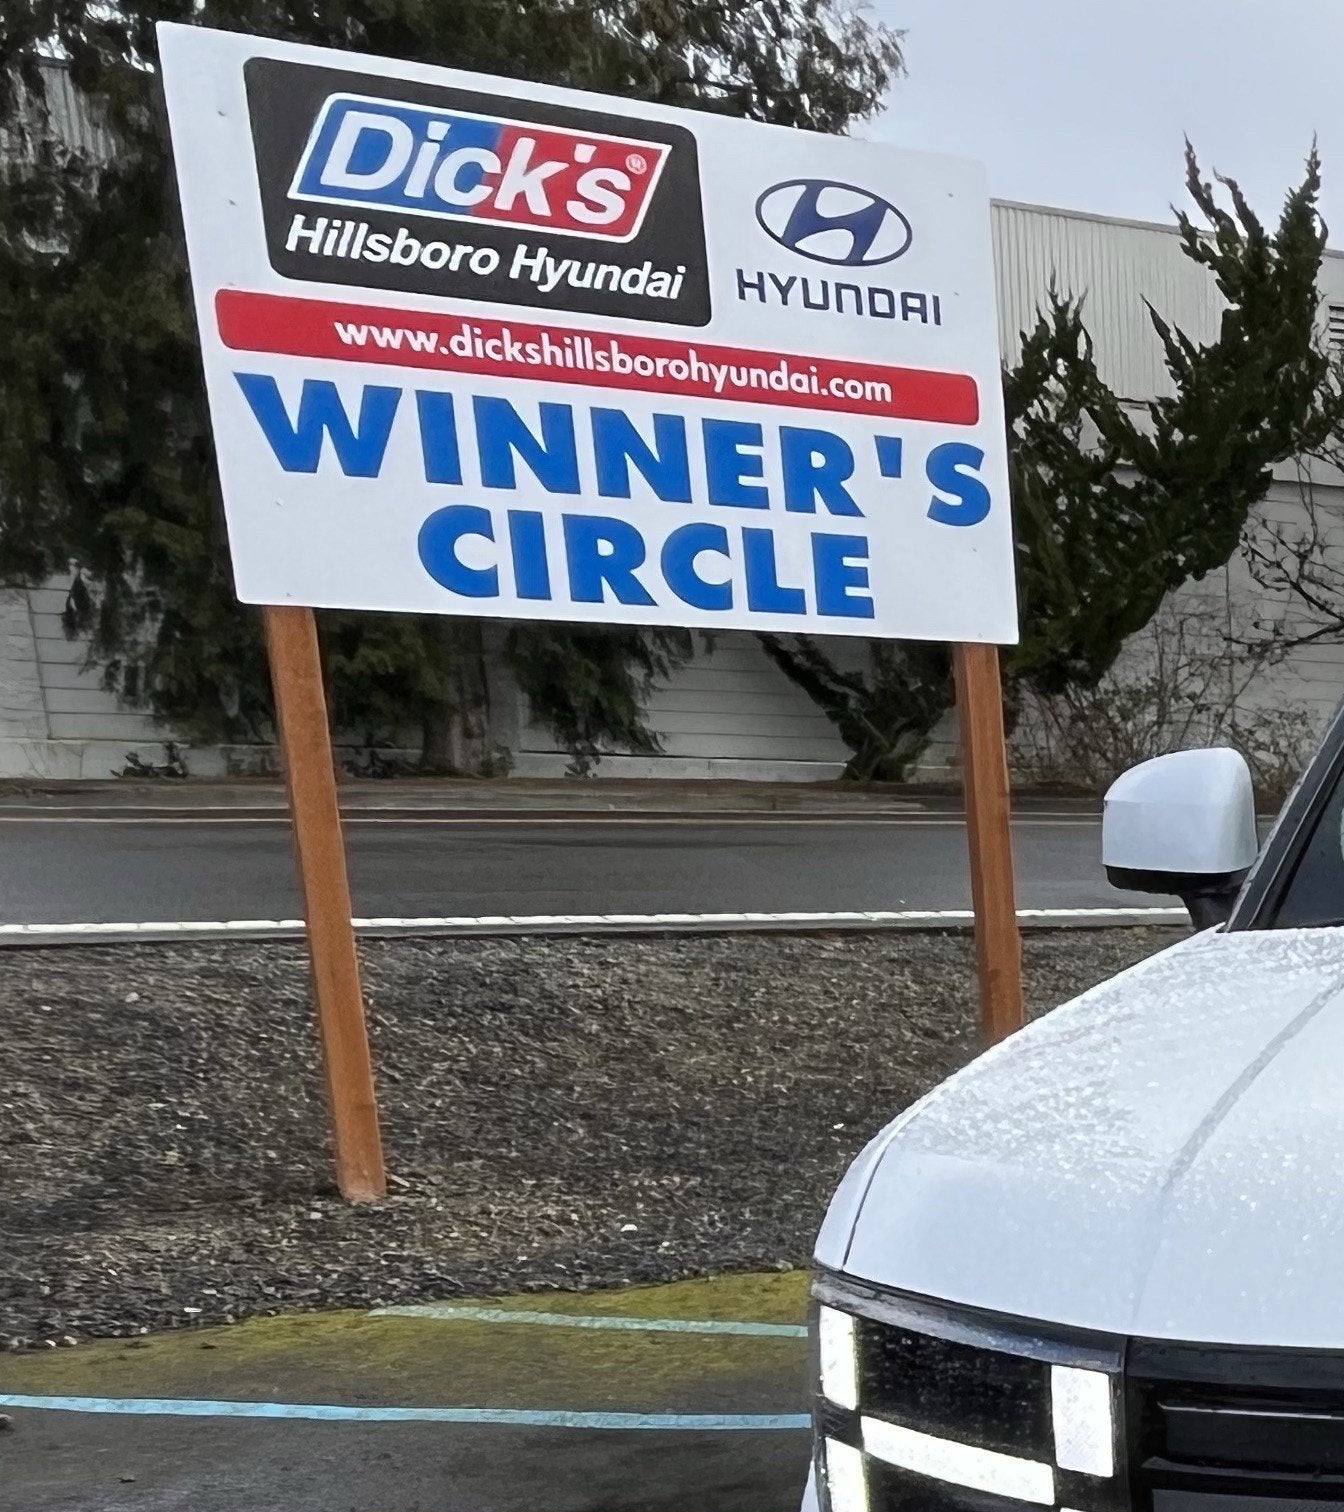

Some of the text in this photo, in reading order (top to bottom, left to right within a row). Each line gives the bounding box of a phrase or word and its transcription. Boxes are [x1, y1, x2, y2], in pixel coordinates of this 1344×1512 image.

[320, 109, 632, 227] Dick's
[285, 215, 687, 301] Hillsboro Hyundai
[736, 268, 942, 326] HYUNDAI
[334, 316, 893, 405] www.dickshillsborohyundai.com
[233, 372, 992, 527] WINNER'S
[416, 504, 876, 620] CIRCLE
